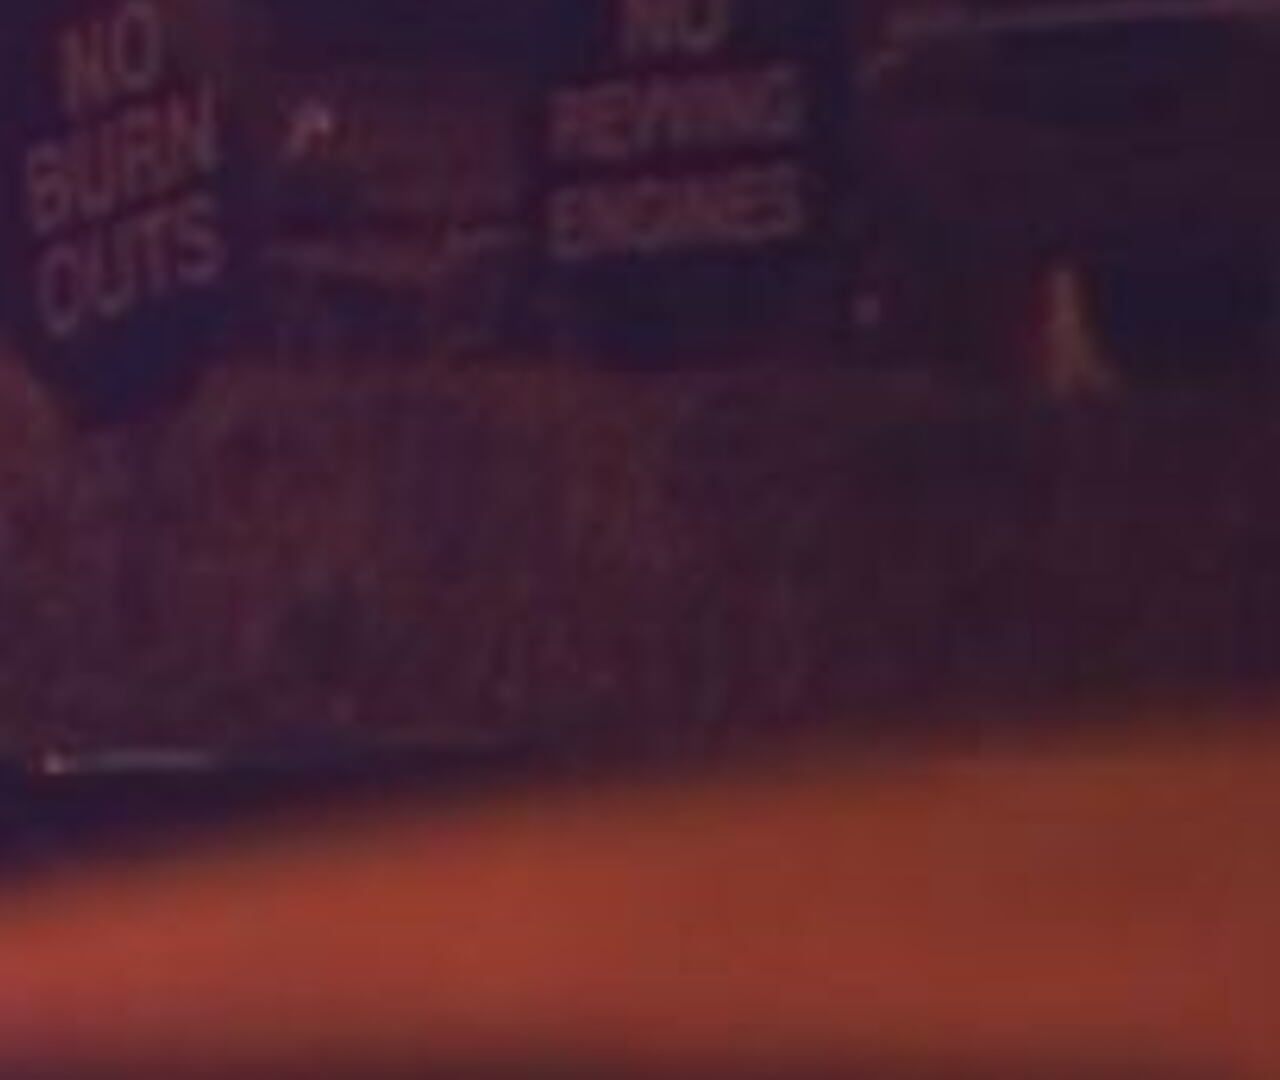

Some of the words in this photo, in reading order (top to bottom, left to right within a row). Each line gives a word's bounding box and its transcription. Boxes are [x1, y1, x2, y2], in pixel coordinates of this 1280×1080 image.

[26, 75, 219, 235] BURN
[547, 160, 807, 260] ENGINES
[36, 190, 226, 337] OUTS
